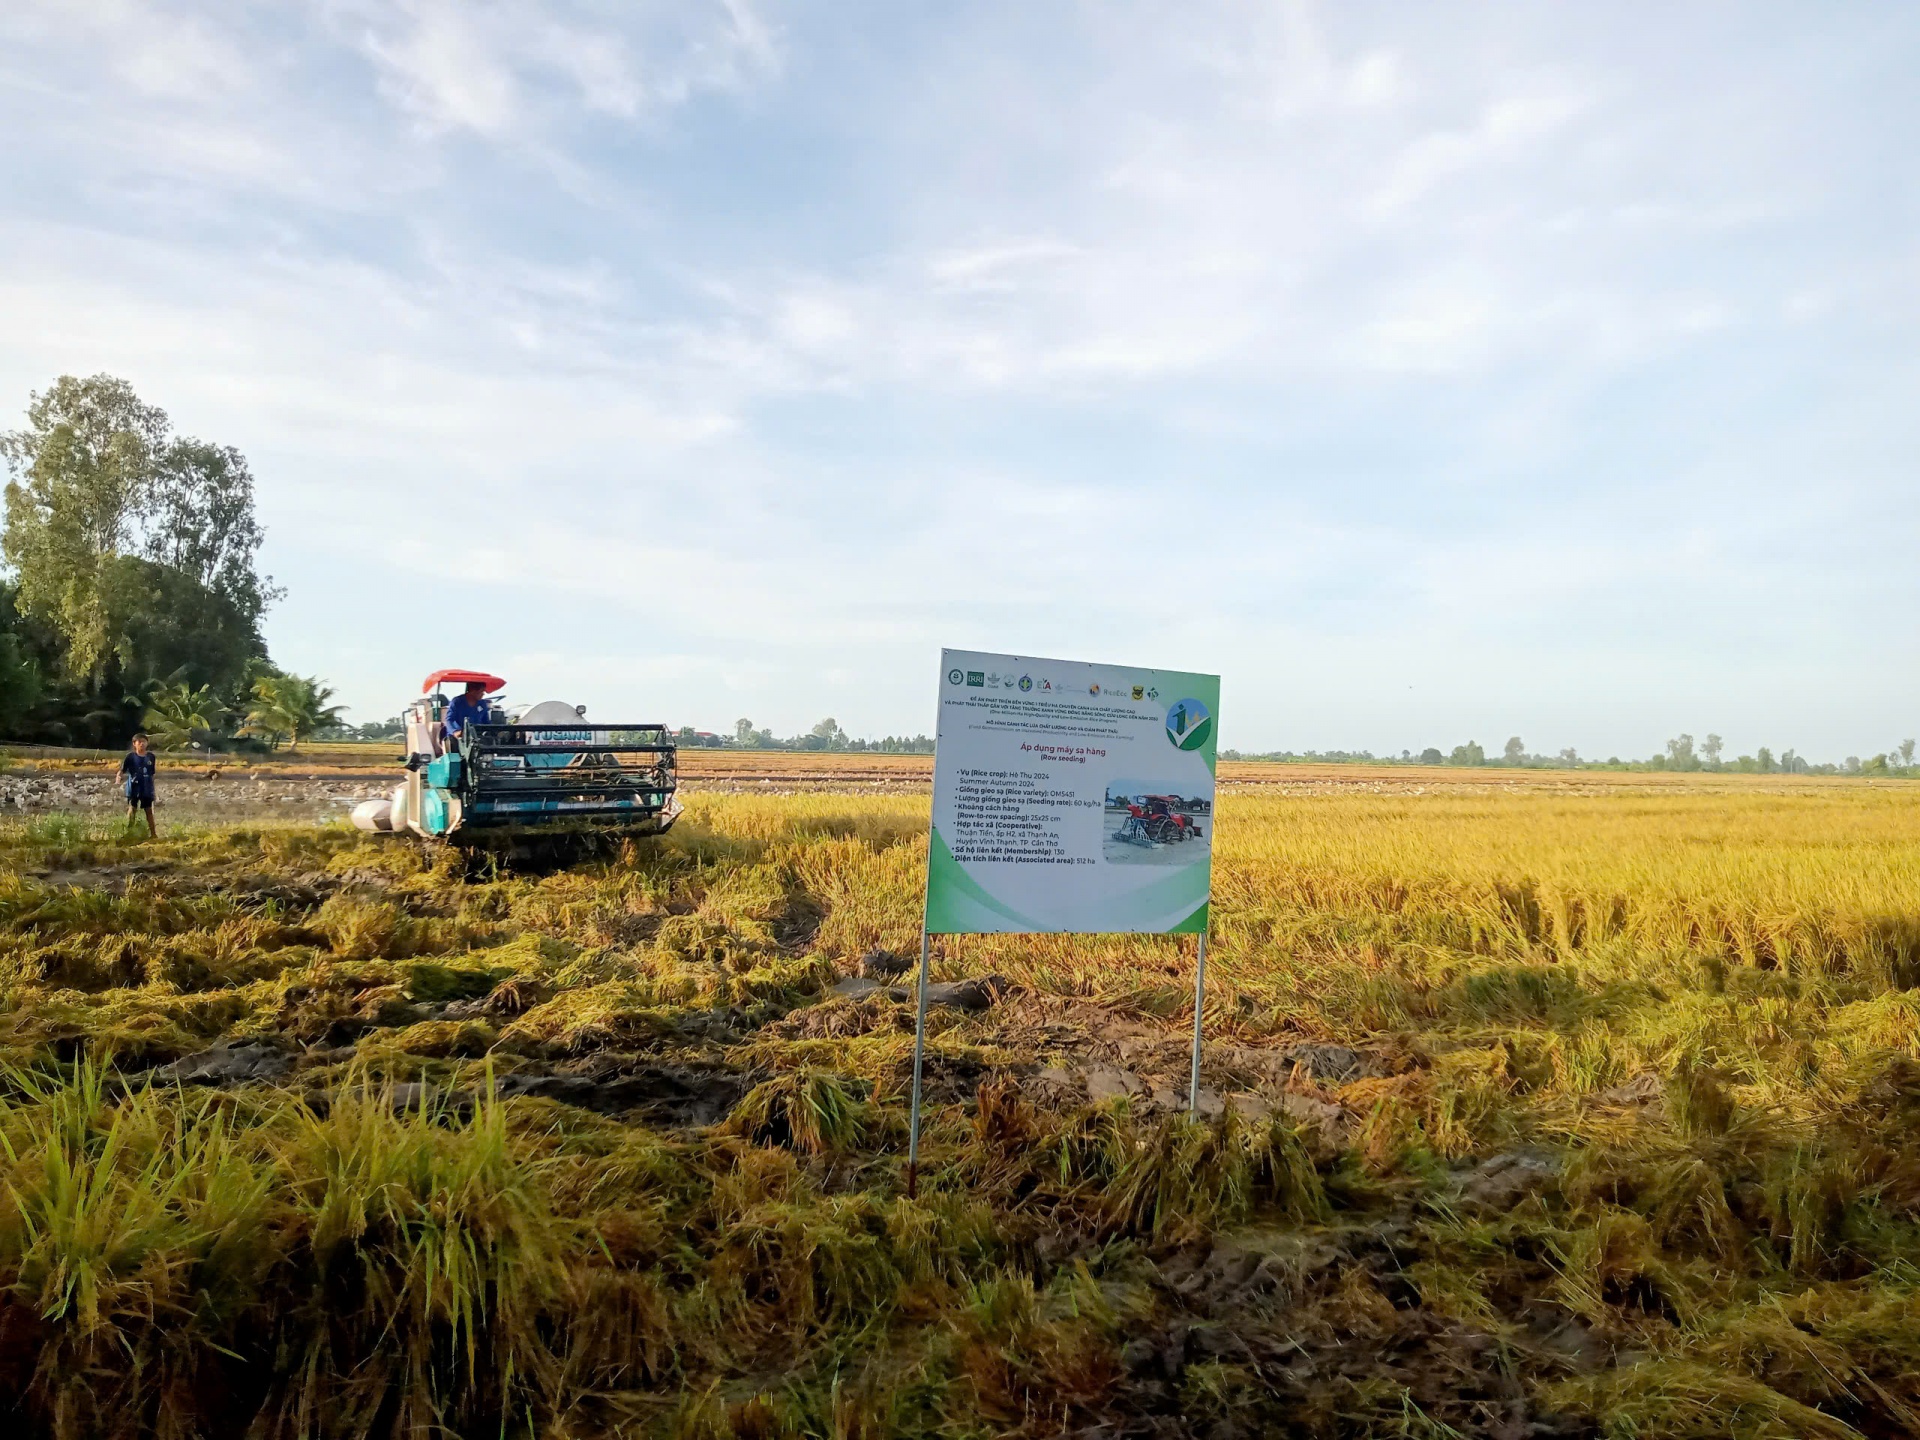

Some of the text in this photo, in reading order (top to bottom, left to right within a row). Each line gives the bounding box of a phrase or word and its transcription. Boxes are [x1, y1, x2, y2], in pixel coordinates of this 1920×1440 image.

[968, 675, 983, 683] IRRI
[1020, 742, 1032, 752] Áp
[1034, 744, 1055, 753] dụng
[1057, 746, 1073, 755] máy
[1086, 747, 1106, 757] hàng
[1058, 755, 1085, 764] seeding)
[971, 769, 987, 777] (Rice
[959, 786, 979, 794] Giống
[1023, 789, 1049, 797] variety):
[1050, 790, 1075, 798] OM5451
[958, 795, 979, 803] Lượng
[981, 795, 1000, 803] giống
[1027, 798, 1054, 806] (Seeding
[958, 803, 984, 811] Khoảng
[1003, 805, 1019, 813] hàng
[995, 822, 1042, 830] (Cooperative):
